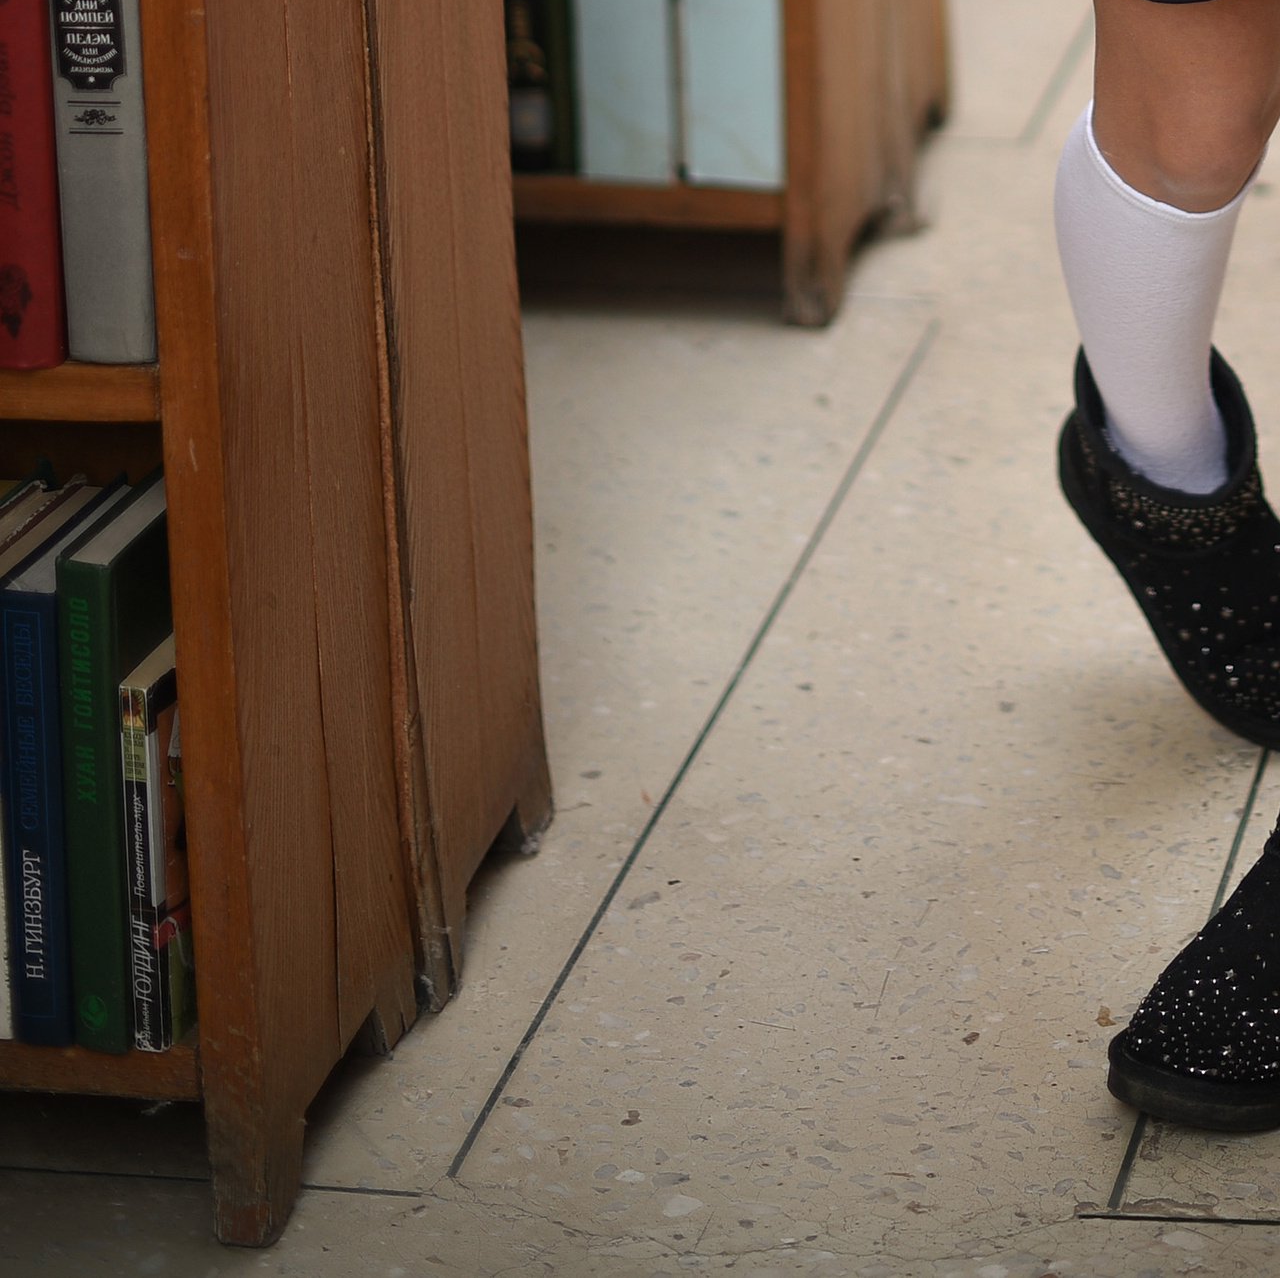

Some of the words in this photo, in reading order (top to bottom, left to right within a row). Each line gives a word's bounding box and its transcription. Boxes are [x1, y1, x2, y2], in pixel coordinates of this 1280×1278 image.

[60, 10, 114, 23] ПОМПЕЙ
[74, 0, 98, 11] ДНИ
[63, 47, 118, 64] ПРИКЛЮЧЕНИЯ
[14, 622, 35, 706] БЕСЕДЫ
[68, 596, 93, 730] ГОЙТИСОЛО
[16, 715, 39, 830] СЕМЕЙНЫЕ
[76, 745, 97, 804] ХУАН
[132, 795, 144, 819] мух
[133, 822, 146, 898] Повелитель
[132, 915, 153, 1002] ГОЛДИНГ
